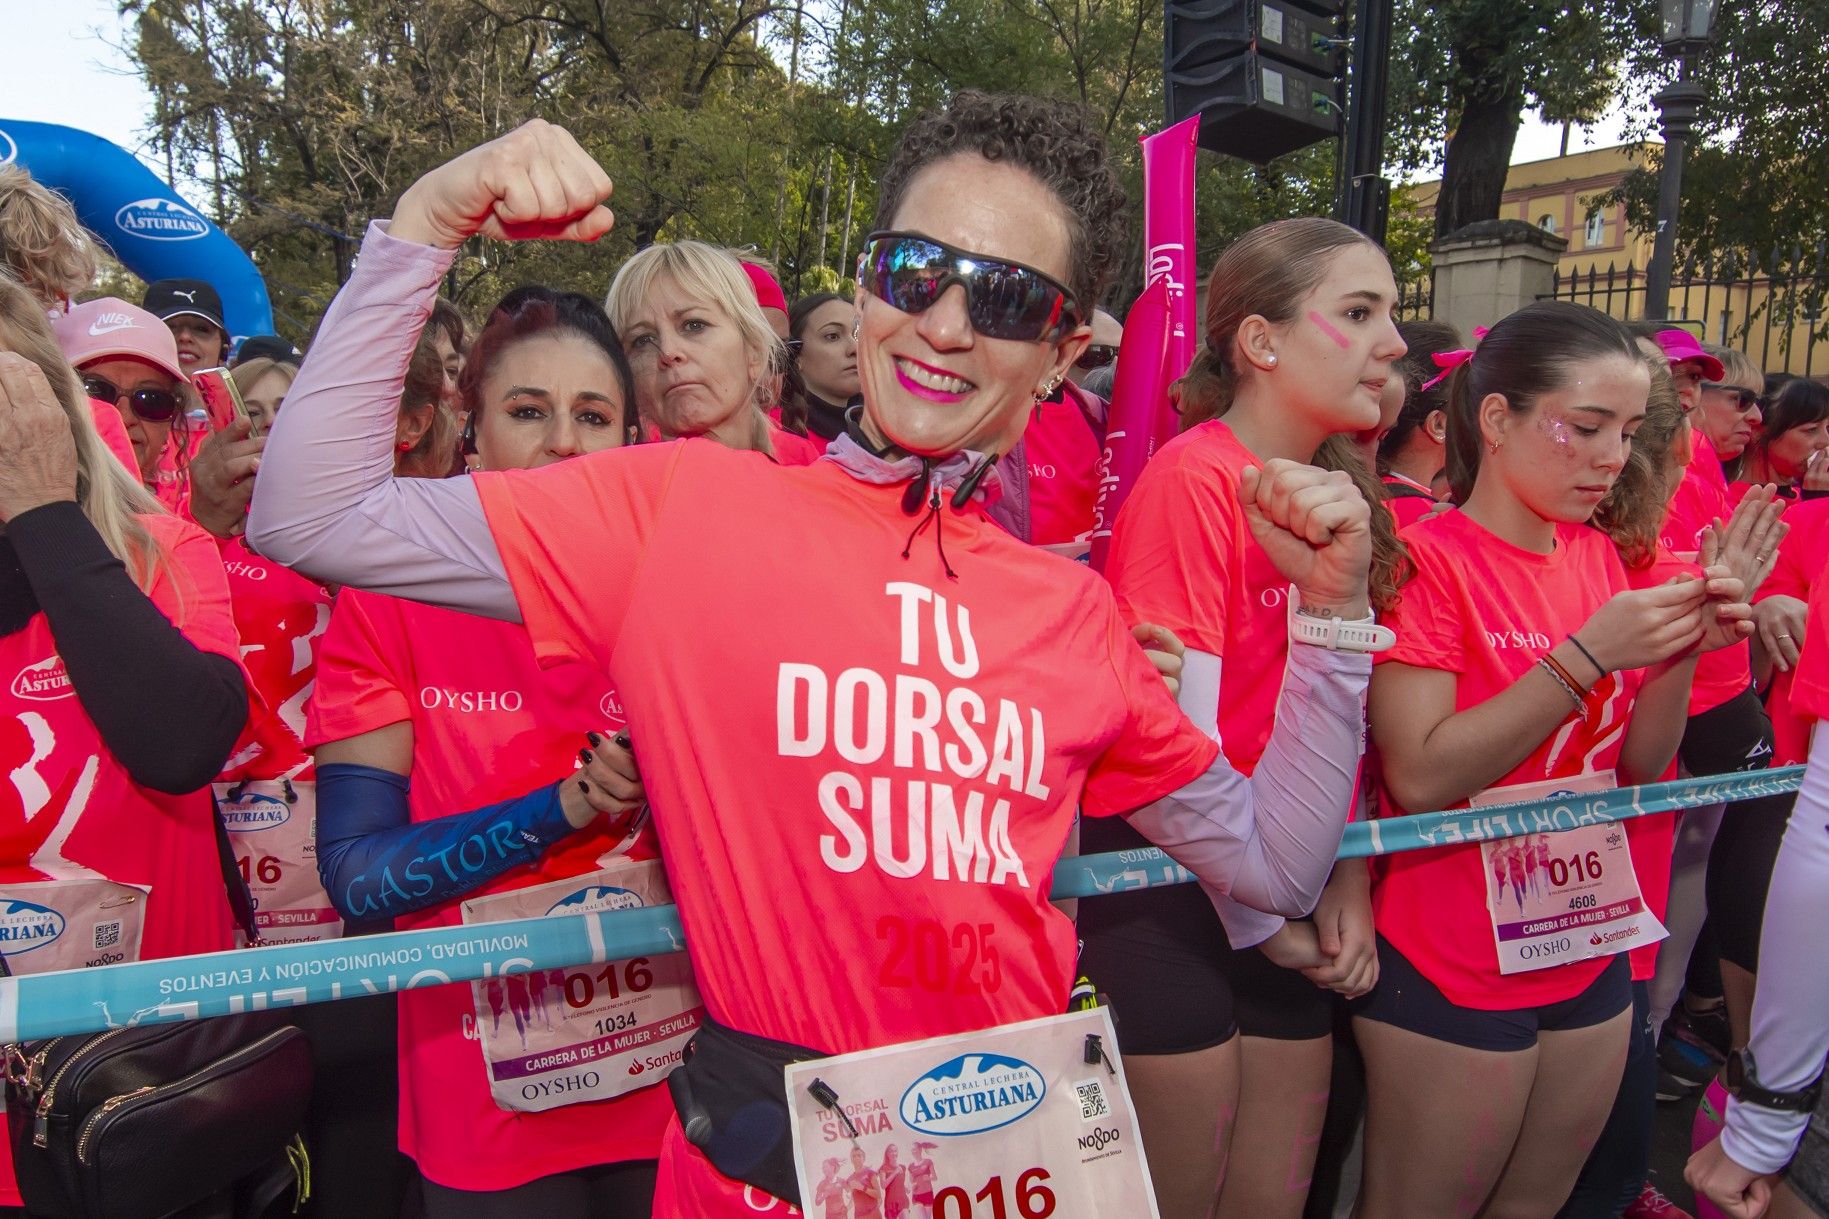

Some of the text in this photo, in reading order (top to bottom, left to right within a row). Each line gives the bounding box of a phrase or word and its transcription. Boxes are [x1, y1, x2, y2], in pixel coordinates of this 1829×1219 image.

[124, 211, 204, 232] ASTURIANA
[224, 561, 267, 580] SHO
[886, 581, 980, 679] TU
[19, 675, 72, 695] ASTUR
[421, 686, 522, 714] OYSHO
[777, 662, 1050, 801] DORSAL
[221, 811, 282, 824] STURIANA
[817, 771, 1030, 888] SUMA
[237, 855, 282, 884] 16
[346, 820, 525, 917] GASTOR
[1549, 850, 1602, 886] 016
[1569, 894, 1597, 910] 4608
[0, 923, 57, 941] RIANA
[278, 912, 317, 924] SEVILLA
[1523, 920, 1558, 935] CARRERA
[1560, 919, 1568, 928] DE
[1569, 917, 1579, 925] LA
[1581, 911, 1606, 923] MUJER
[427, 934, 528, 961] MOVILIDAD,
[875, 915, 1001, 995] 2025
[1520, 925, 1640, 960] OYSHO Santander
[258, 967, 271, 982] Y
[276, 948, 423, 982] COMUNICACIÓN
[160, 968, 252, 994] EVENTOS
[564, 957, 654, 1009] 016
[595, 1011, 637, 1035] 1034
[526, 1014, 696, 1072] CARRERA DE LA MUJER SEVILLA
[521, 1050, 682, 1101] OYSHO Santa
[932, 1071, 1030, 1096] CENTRAL LECHERA
[815, 1098, 889, 1122] TU ORSAL
[913, 1081, 1038, 1123] ASTURIANA
[822, 1112, 893, 1143] SUMA
[931, 1166, 1057, 1219] 016
